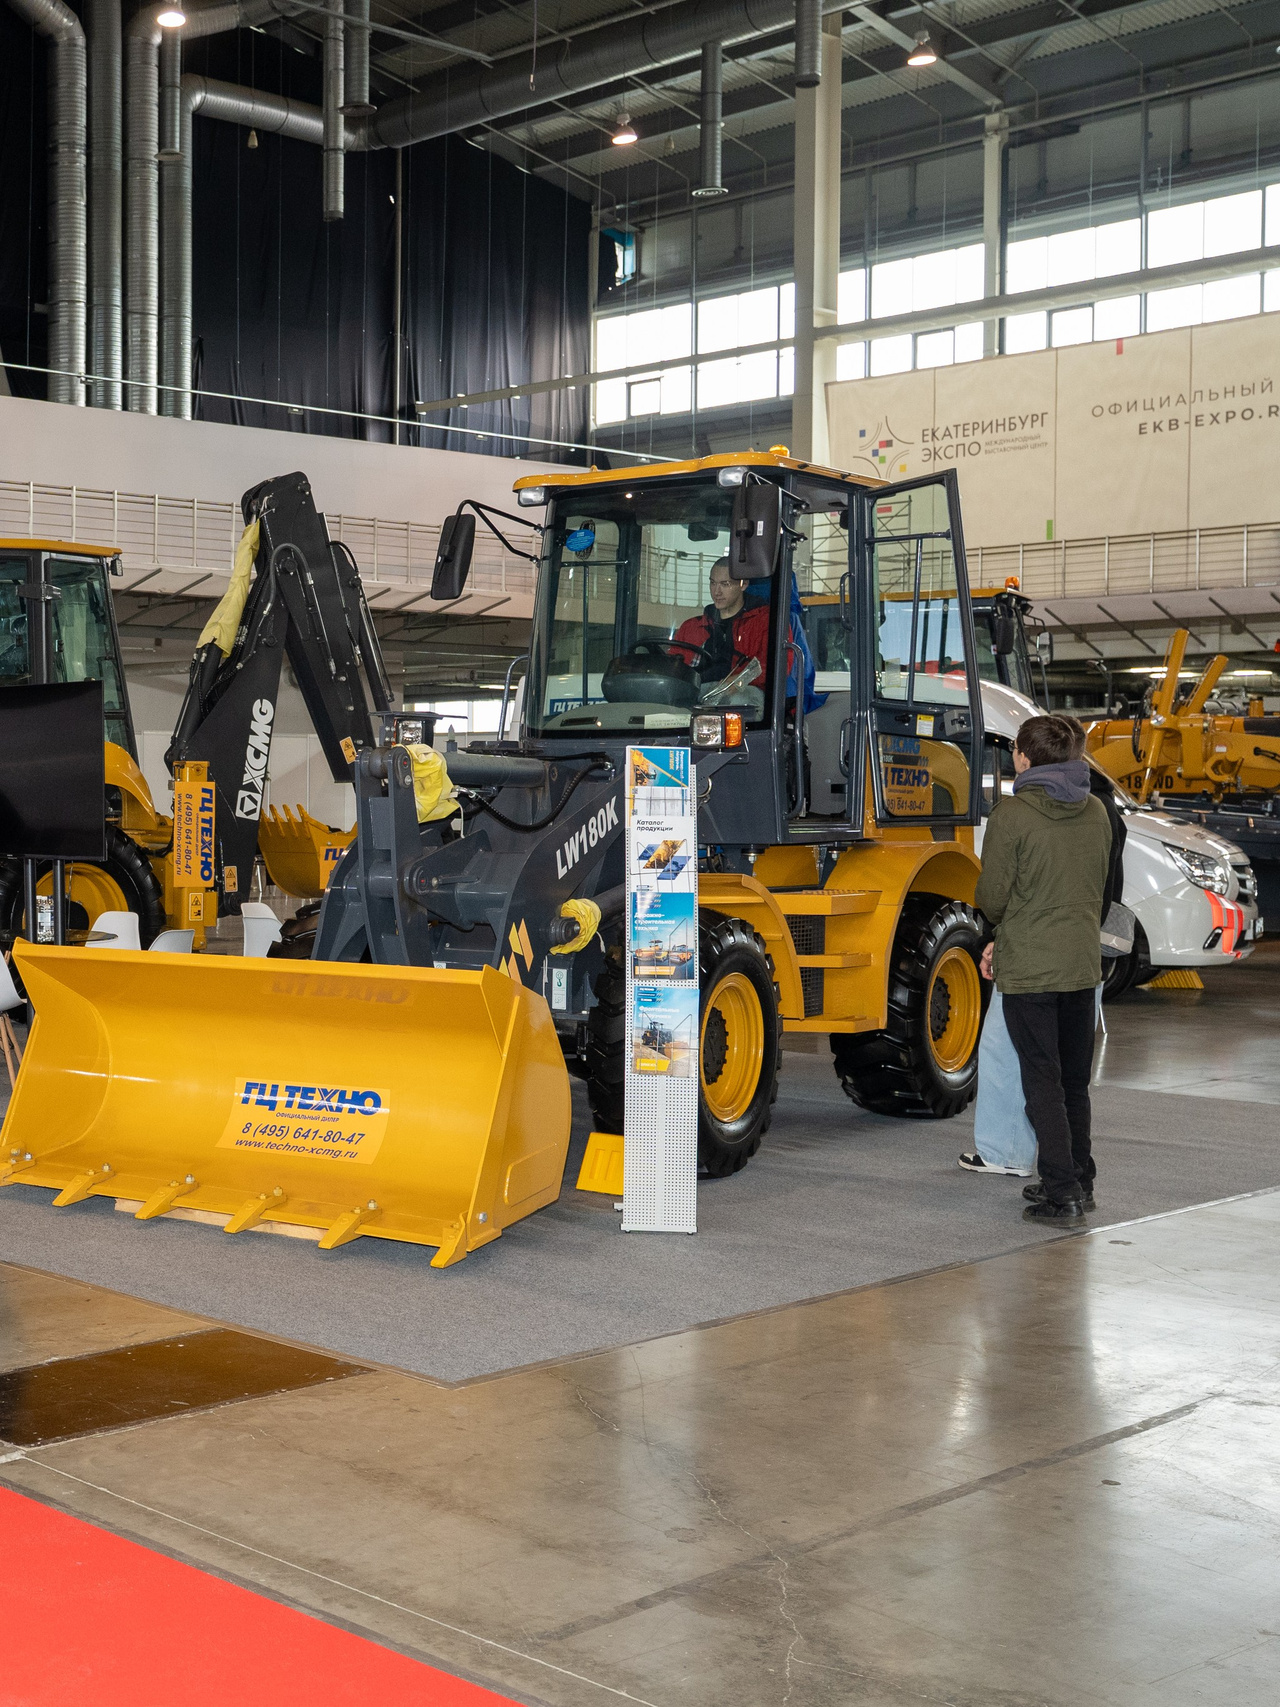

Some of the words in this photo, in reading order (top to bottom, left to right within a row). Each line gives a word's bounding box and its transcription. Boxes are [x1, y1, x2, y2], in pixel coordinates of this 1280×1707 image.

[1091, 377, 1273, 418] ОФИЦИАЛЬНЫЙ
[921, 412, 1049, 444] ЕКАТЕРИНБУРГ
[921, 441, 981, 463] ЭКСПО
[242, 698, 275, 794] XCMG
[891, 766, 929, 787] ТЕХНО
[184, 802, 193, 825] (495)
[198, 787, 213, 813] ГЦ
[175, 793, 183, 876] www.techno-xcmg.ru
[199, 816, 214, 882] ТЕХНО
[556, 795, 619, 880] LW180K
[184, 829, 193, 875] 641-80-47
[241, 1082, 279, 1112] ГЦ
[283, 1085, 383, 1117] ТЕХНО
[276, 1111, 320, 1121] ОФИЦИАЛЬНЫЙ
[235, 1138, 359, 1159] www.techno-xcmg.ru
[241, 1122, 252, 1134] 8
[253, 1123, 290, 1141] (495)
[293, 1127, 366, 1146] 641-80-47
